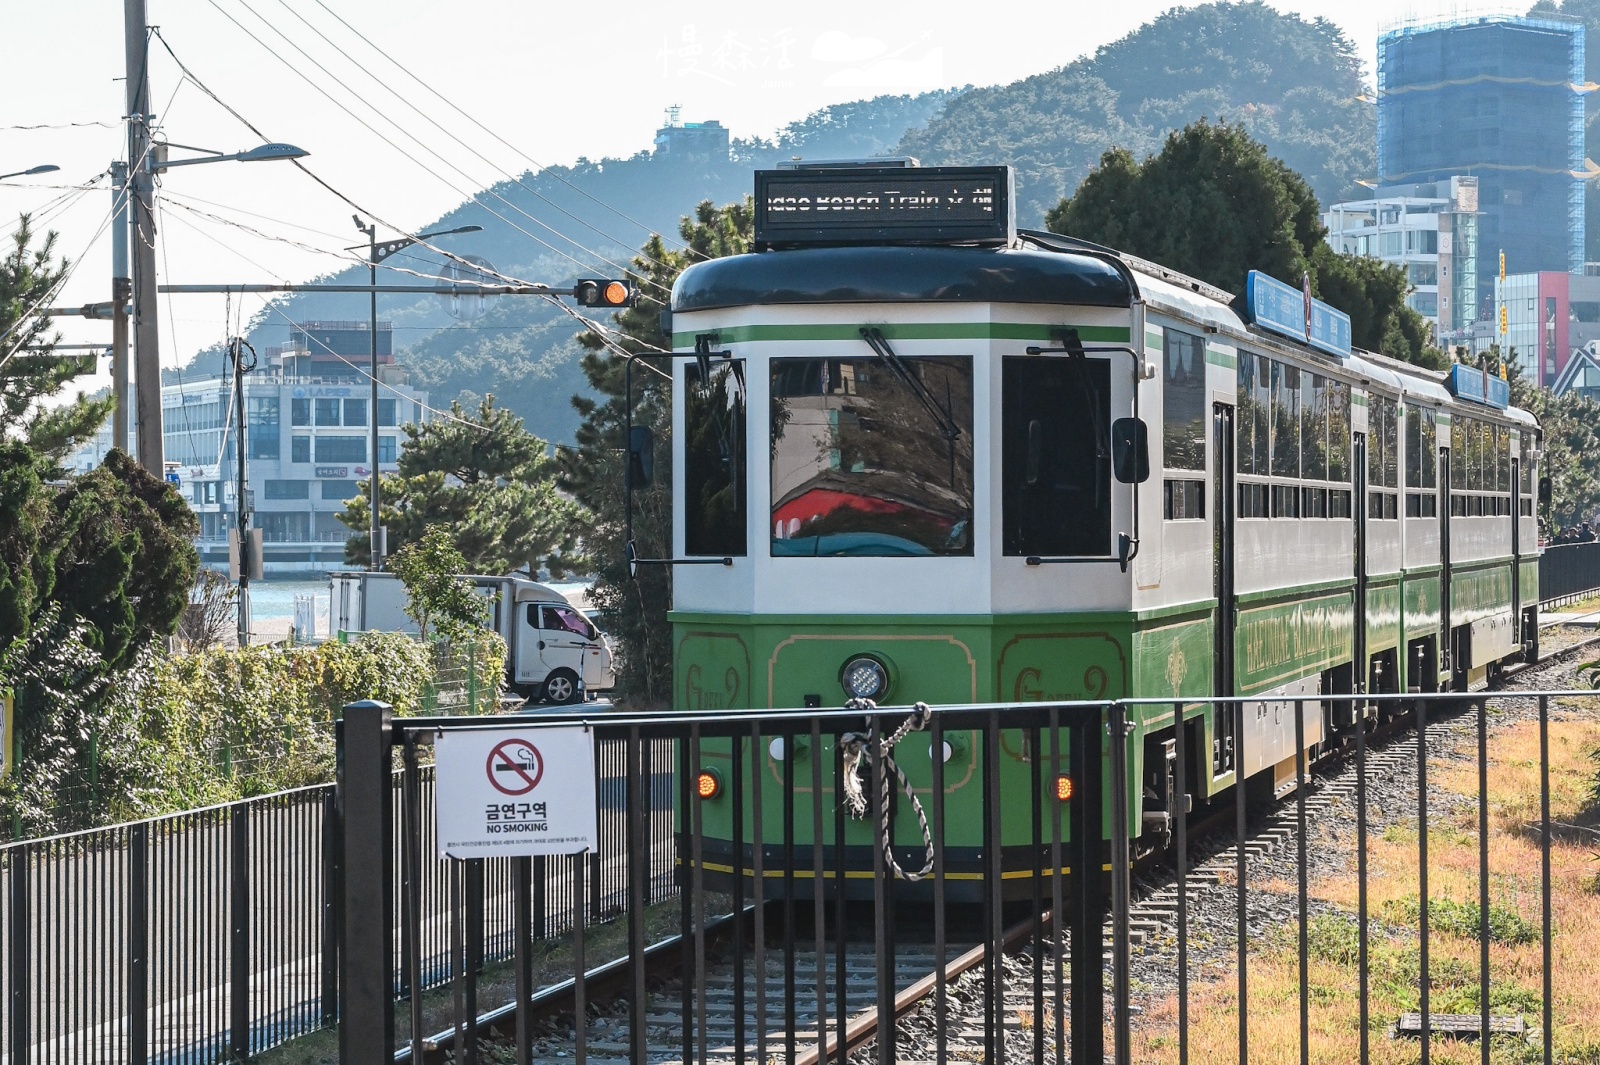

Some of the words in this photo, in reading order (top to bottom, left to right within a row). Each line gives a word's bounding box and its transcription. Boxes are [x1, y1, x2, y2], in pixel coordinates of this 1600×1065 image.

[485, 801, 547, 821] 금연구역
[486, 824, 502, 834] NO
[502, 822, 549, 833] SMOKING
